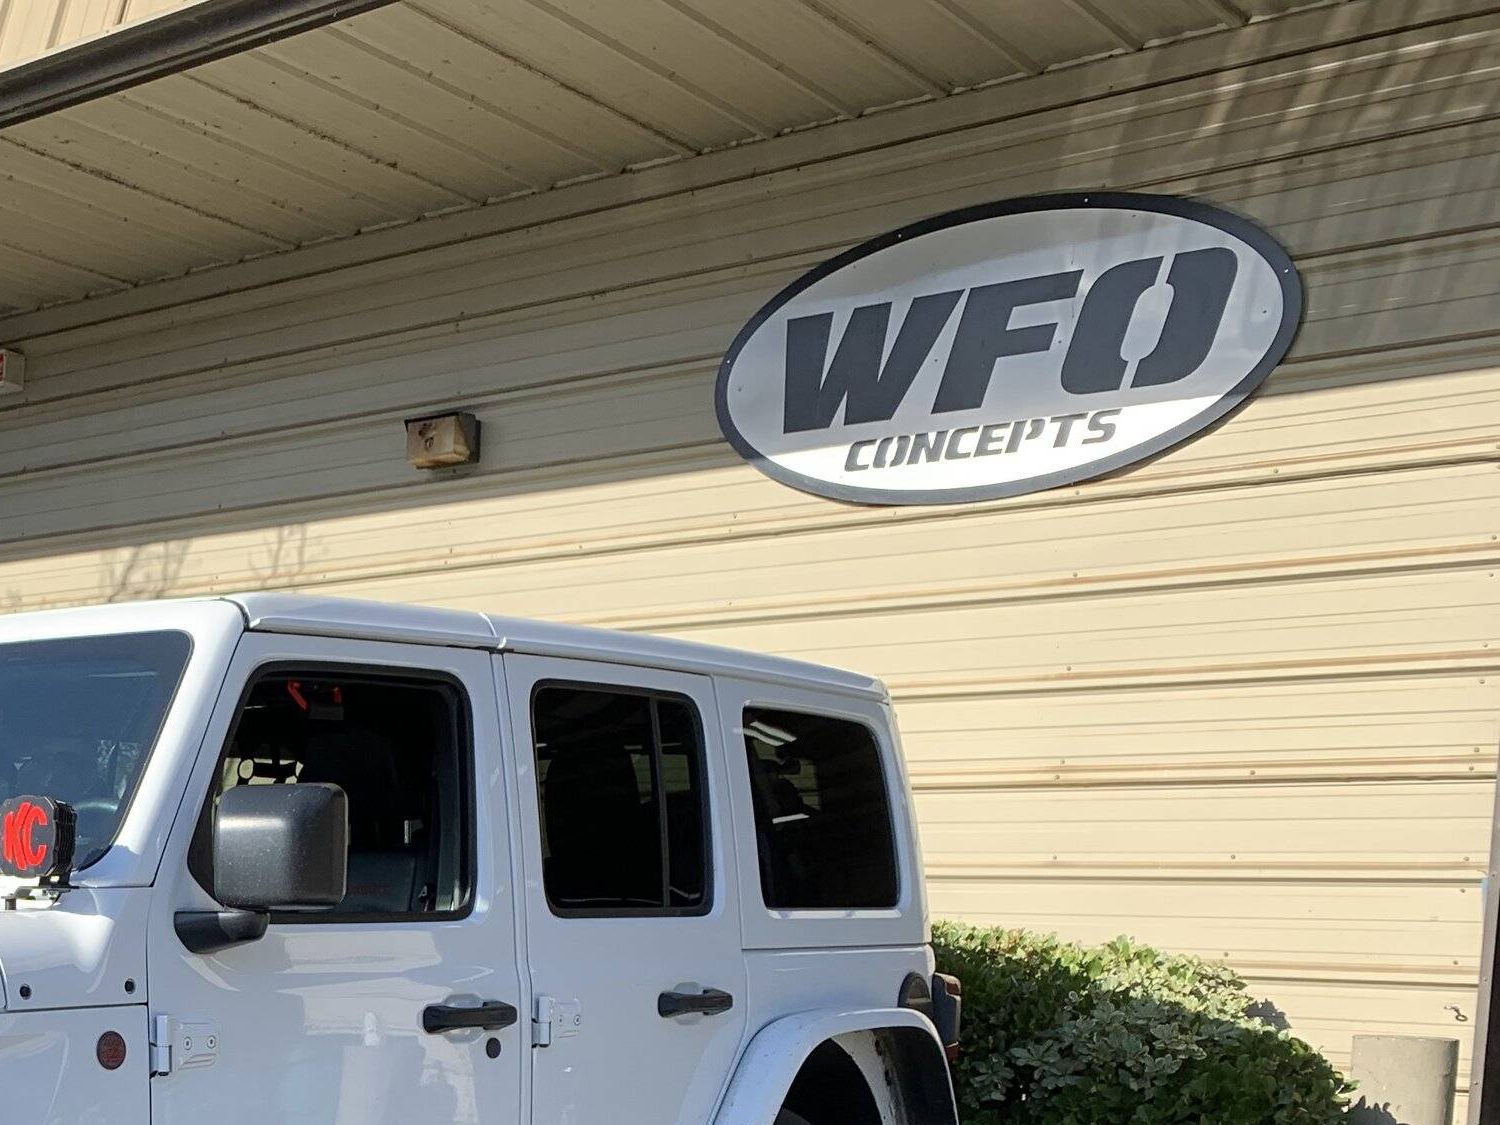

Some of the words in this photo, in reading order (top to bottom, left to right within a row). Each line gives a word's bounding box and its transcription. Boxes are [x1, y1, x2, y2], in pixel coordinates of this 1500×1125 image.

[783, 246, 1239, 435] WFO
[844, 409, 1124, 473] CONCEPTS
[3, 801, 48, 871] KC
